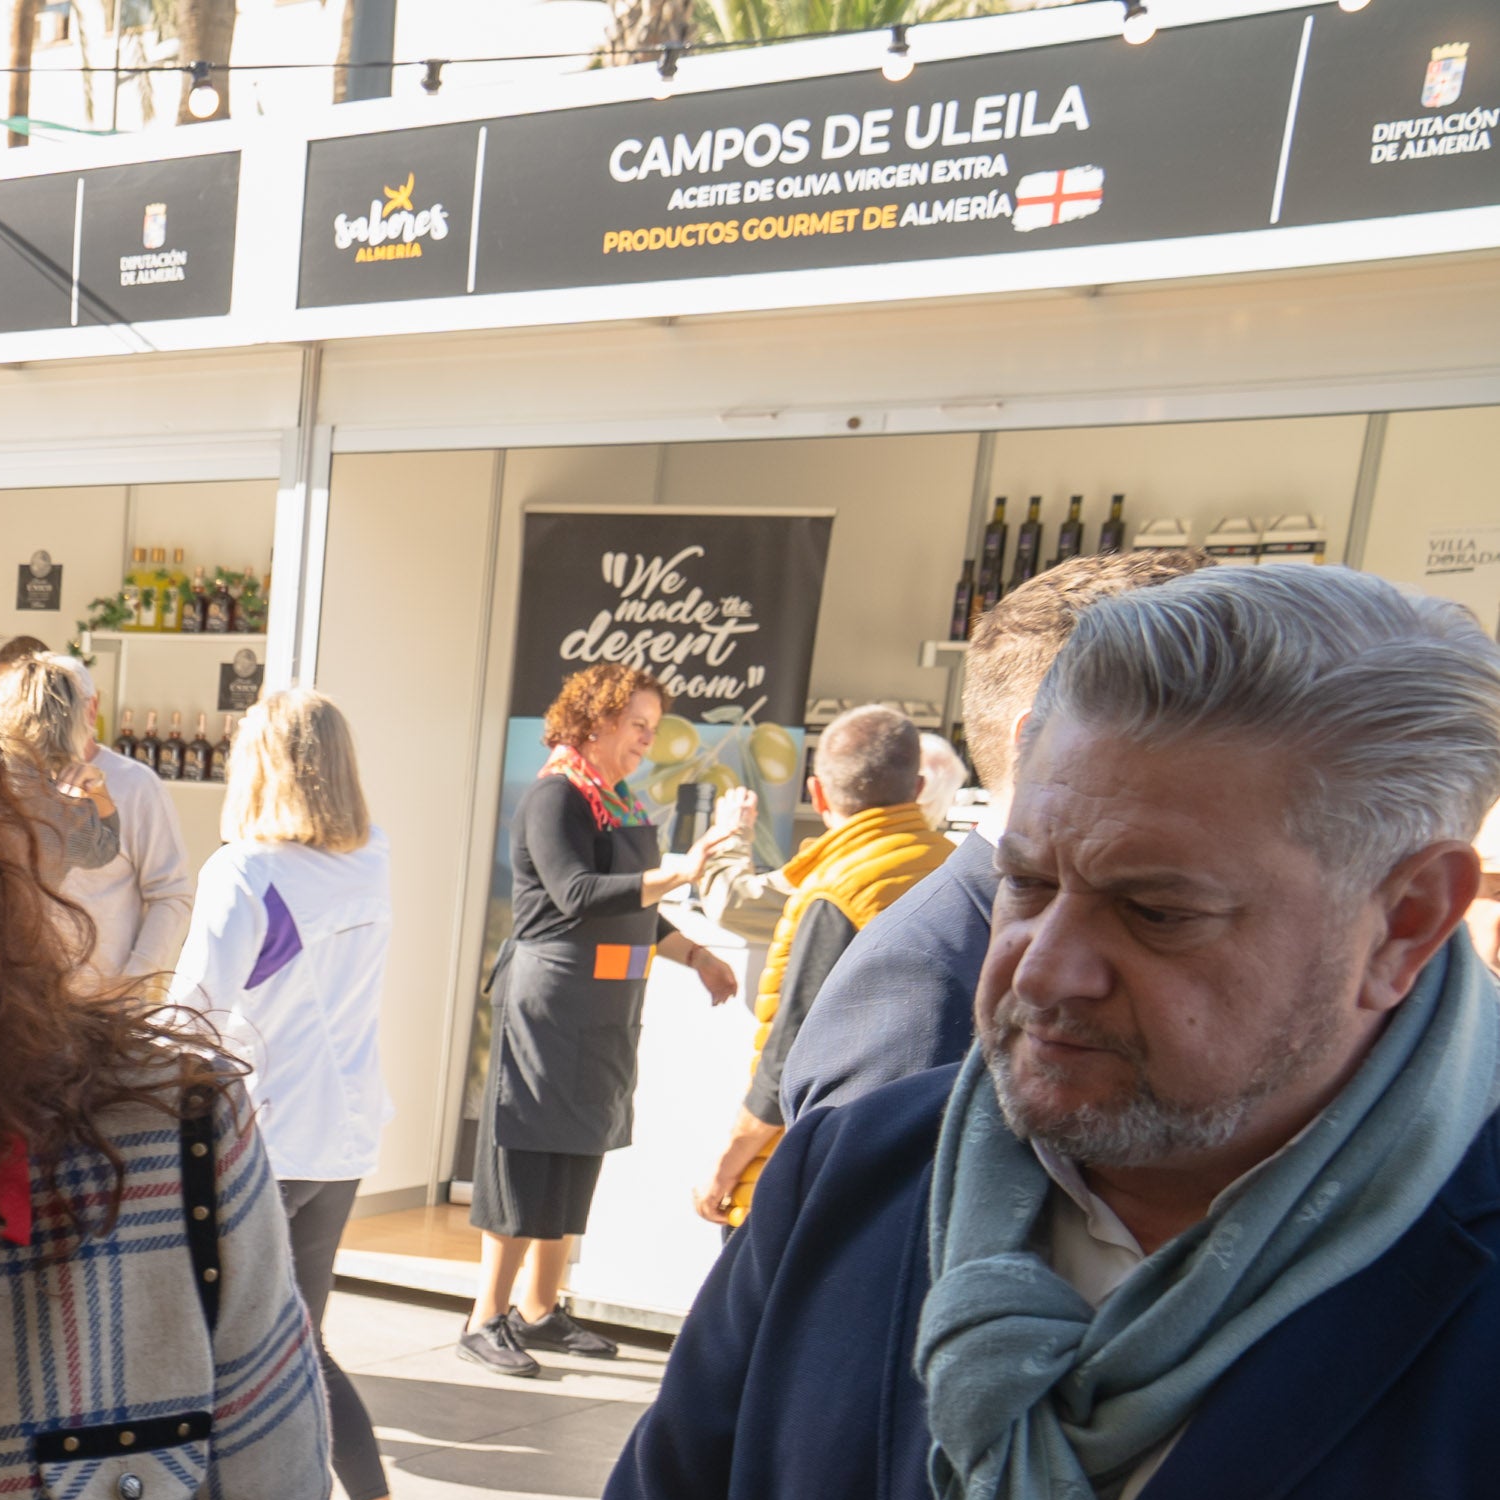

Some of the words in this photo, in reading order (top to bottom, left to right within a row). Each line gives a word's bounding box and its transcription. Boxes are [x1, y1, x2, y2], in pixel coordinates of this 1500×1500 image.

[608, 118, 811, 183] CAMPOS
[821, 108, 894, 160] DE
[904, 85, 1091, 150] ULEILA
[1372, 106, 1500, 143] DIPUTACIÓN
[1370, 142, 1399, 164] DE
[1399, 129, 1491, 160] ALMERÍA
[667, 181, 741, 212] ACEITE
[743, 176, 775, 203] DE
[776, 171, 842, 201] OLIVA
[844, 162, 929, 192] VIRGEN
[931, 153, 1009, 187] EXTRA
[602, 220, 740, 255] PRODUCTOS
[741, 208, 860, 243] GOURMET
[863, 204, 898, 232] DE
[898, 190, 1012, 228] ALMERÍA
[1430, 537, 1477, 552] VILLA
[614, 587, 720, 625] made
[720, 594, 753, 617] the
[560, 609, 760, 672] desert
[646, 662, 765, 700] loom"
